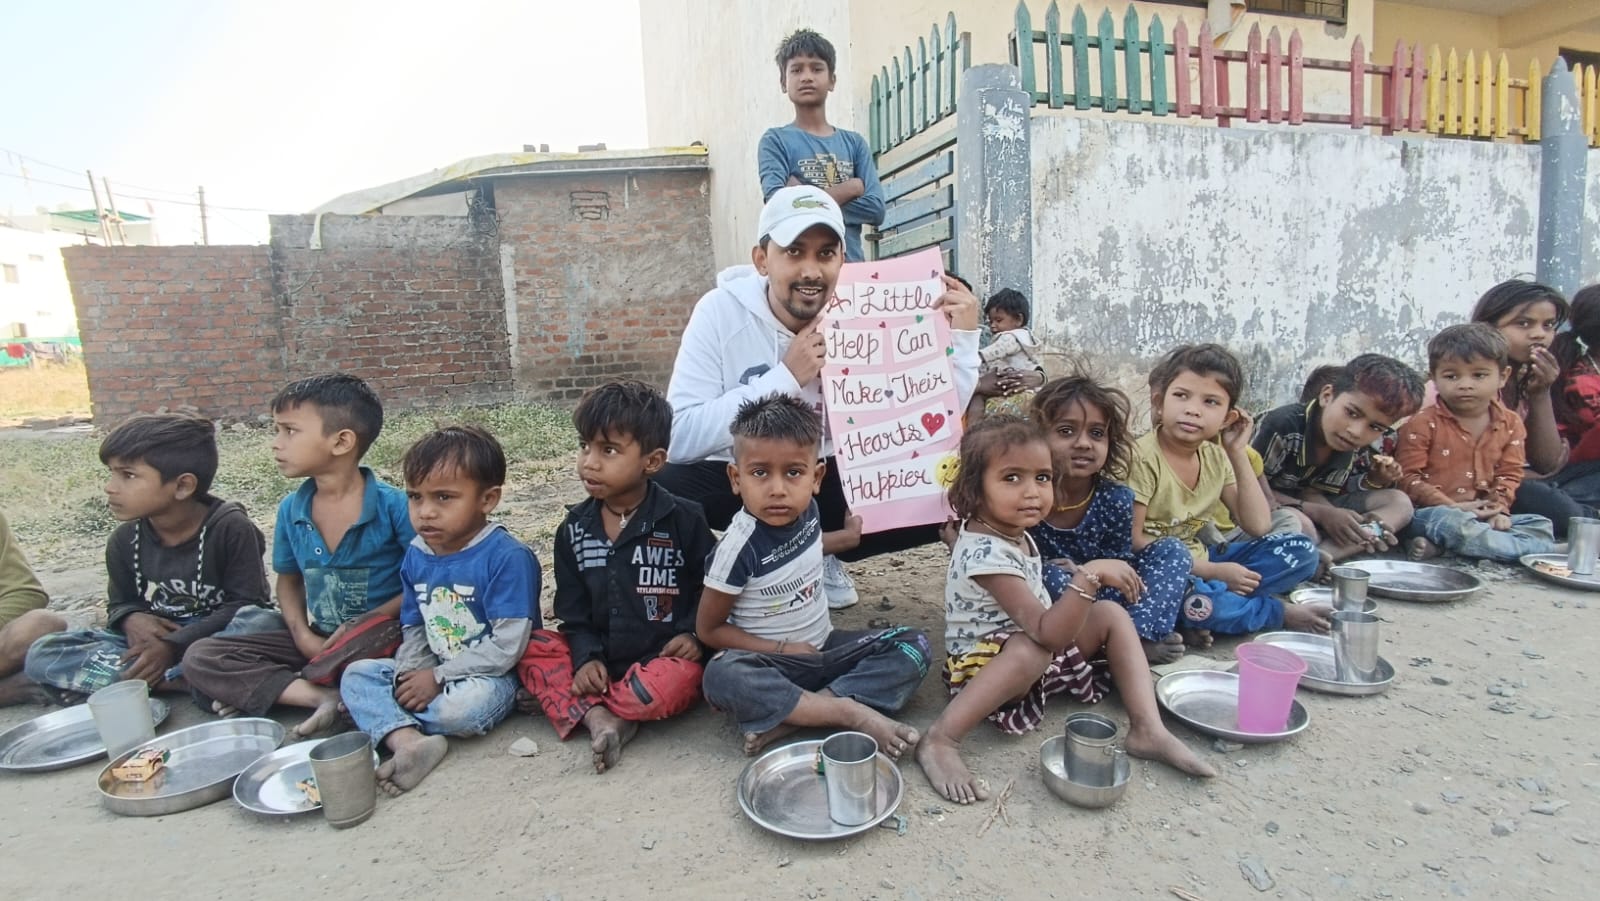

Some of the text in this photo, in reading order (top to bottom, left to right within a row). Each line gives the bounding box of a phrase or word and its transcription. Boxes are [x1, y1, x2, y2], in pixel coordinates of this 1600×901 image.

[826, 285, 934, 316] A Little
[828, 328, 933, 365] Help Can
[831, 371, 948, 406] Make Their
[844, 420, 926, 461] Hearts
[845, 468, 933, 505] Happier
[631, 545, 685, 567] AWES
[638, 566, 678, 588] OME
